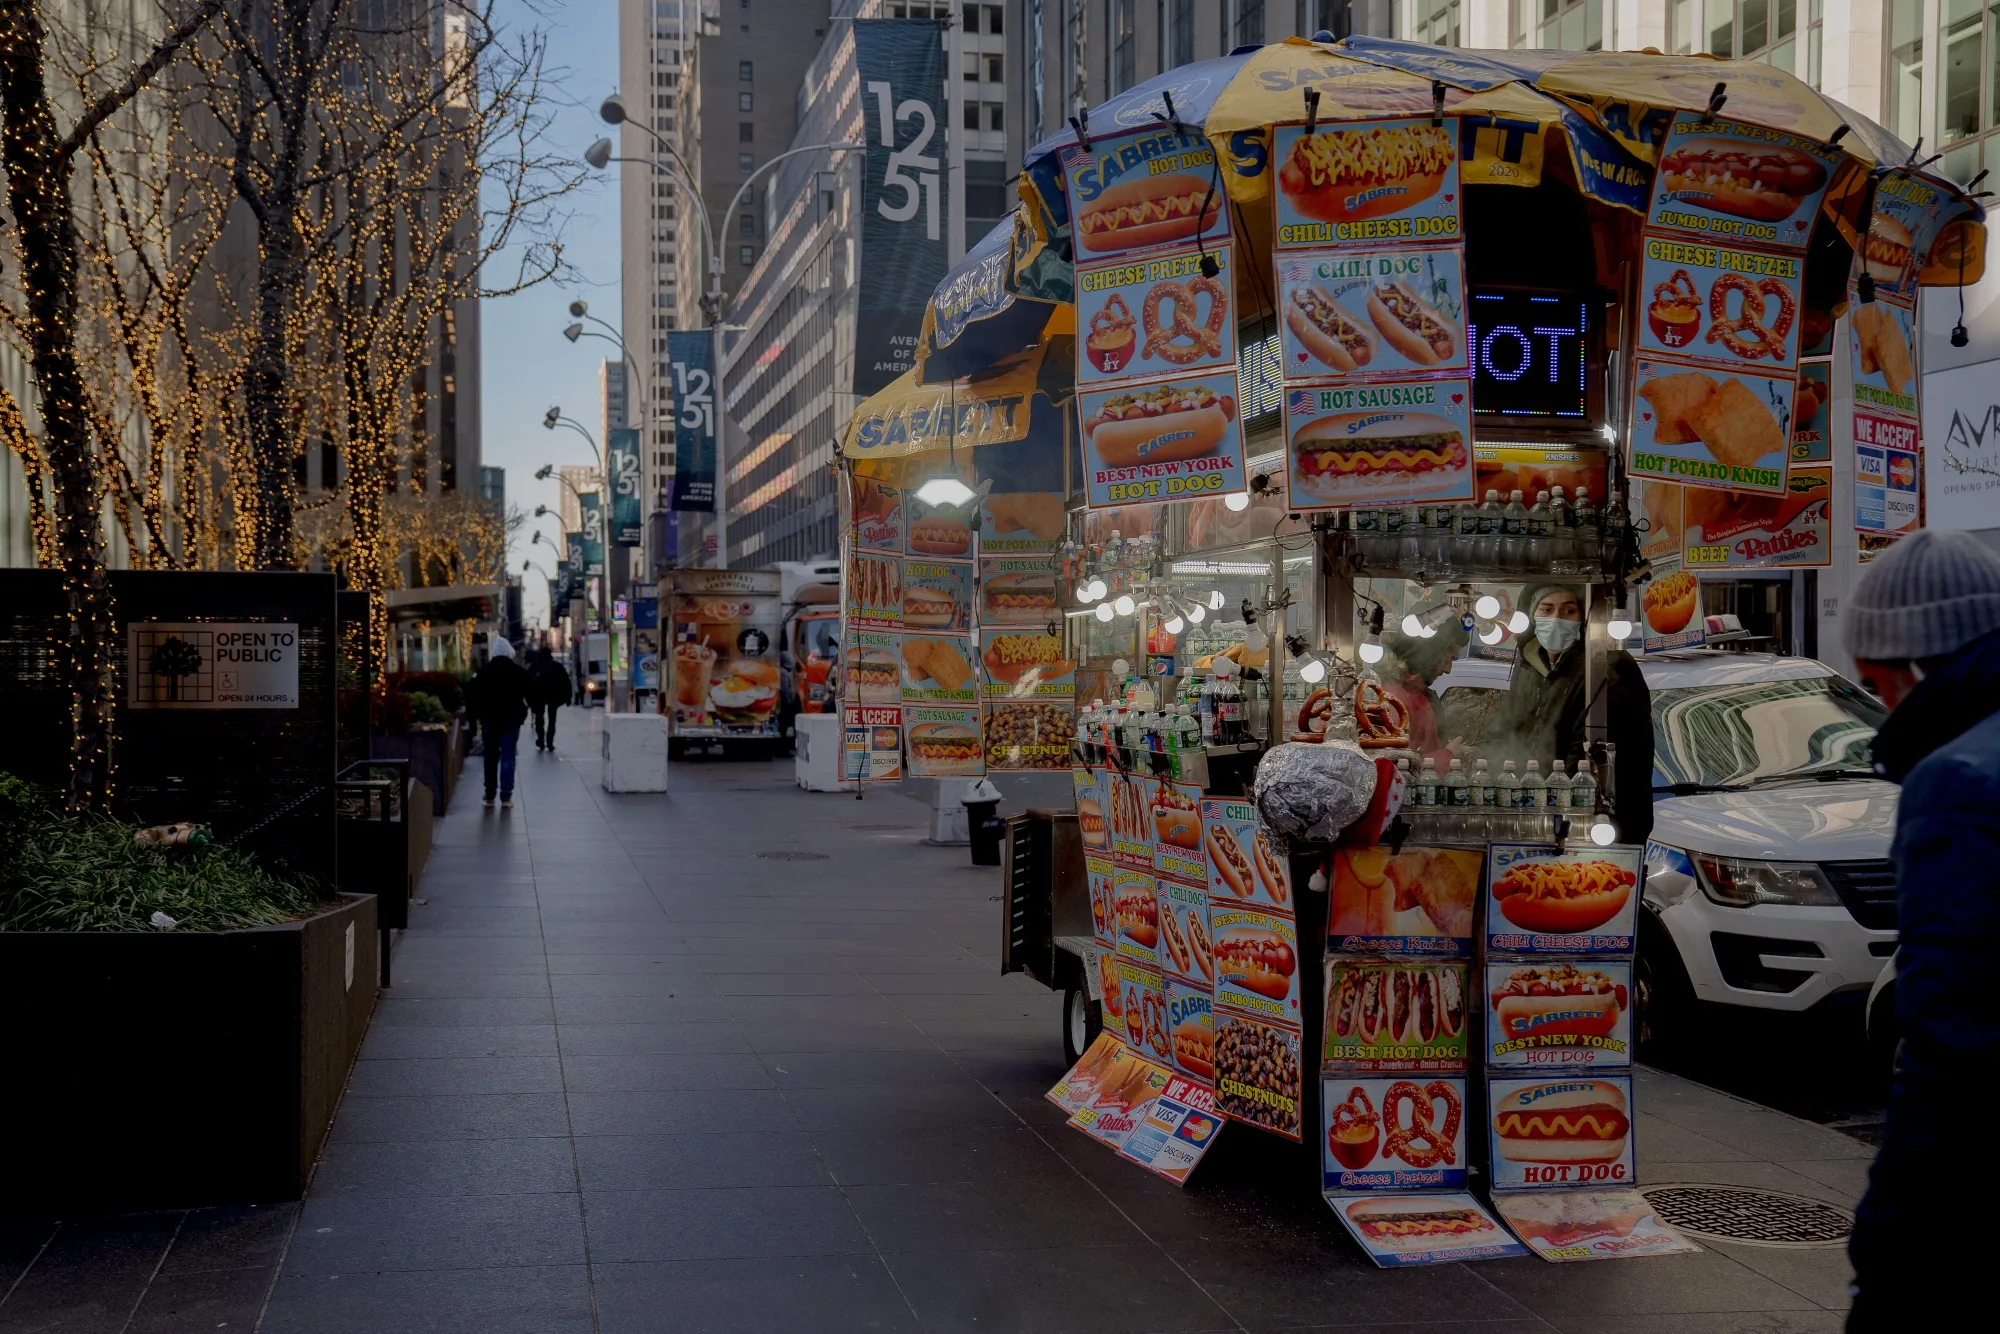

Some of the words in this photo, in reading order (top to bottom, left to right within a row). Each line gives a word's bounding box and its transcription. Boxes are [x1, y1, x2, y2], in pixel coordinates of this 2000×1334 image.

[868, 81, 939, 171] 12
[1674, 121, 1730, 136] BEST
[1733, 124, 1785, 142] NEW
[1148, 157, 1178, 176] HOT
[1181, 149, 1212, 169] DOG
[1488, 165, 1520, 179] 2020
[877, 152, 941, 240] 51
[1344, 185, 1408, 211] SABRETT
[1658, 190, 1715, 205] SABRETT
[1278, 220, 1333, 243] CHILI
[1336, 218, 1412, 240] CHEESE
[1418, 214, 1457, 235] DOG
[1657, 210, 1709, 230] JUMBO
[1711, 218, 1743, 234] HOT
[1744, 223, 1777, 240] DOG
[1316, 259, 1372, 280] CHILI
[1378, 256, 1423, 276] DOG
[1648, 241, 1717, 267] CHEESE
[1720, 251, 1798, 279] PRETZEL
[1081, 262, 1147, 292] CHEESE
[1149, 251, 1225, 281] PRETZL
[1663, 334, 1683, 346] NY
[1102, 361, 1120, 372] NY
[672, 362, 712, 402] 12
[1318, 389, 1356, 410] HOT
[1359, 385, 1436, 408] SAUSAGE
[680, 395, 713, 437] 51
[1346, 413, 1405, 434] SABRETT
[1136, 429, 1196, 458] SABRETT
[1856, 417, 1873, 442] WE
[1875, 422, 1915, 450] ACCEPT
[613, 449, 639, 477] 12
[1544, 453, 1579, 461] KNISHES
[1861, 456, 1881, 474] VISA
[1095, 464, 1138, 484] BEST
[1141, 460, 1177, 478] NEW
[1178, 455, 1235, 475] YORK
[1634, 452, 1668, 471] HOT
[1669, 458, 1729, 480] POTATO
[1731, 465, 1782, 487] KNISH
[616, 471, 640, 499] 51
[1107, 478, 1166, 501] HOT
[1168, 473, 1225, 495] DOG
[1944, 483, 1981, 495] OPENING
[1887, 500, 1915, 513] DISCOVER
[864, 523, 898, 543] Patties
[1706, 533, 1717, 541] The
[1716, 526, 1737, 539] Original
[1736, 521, 1759, 533] Jamaican
[1759, 518, 1774, 527] Style
[983, 540, 1005, 549] HOT
[1687, 545, 1731, 563] BEEF
[1734, 528, 1818, 560] Patties
[905, 563, 929, 577] HOT
[930, 566, 951, 578] DOG
[1000, 560, 1019, 571] HOT
[865, 609, 880, 618] HOT
[881, 610, 900, 619] DOG
[216, 632, 266, 646] OPEN
[270, 632, 294, 646] TO
[866, 634, 892, 646] SAUSAGE
[216, 649, 282, 662] PUBLIC
[217, 694, 243, 702] OPEN
[244, 694, 255, 702] 24
[256, 694, 288, 702] HOURS
[862, 710, 898, 724] ACCEPT
[917, 710, 932, 720] HOT
[933, 710, 966, 721] SAUSAGE
[846, 733, 865, 743] VISA
[1225, 805, 1256, 821] CHILI
[1156, 843, 1173, 855] BEST
[1173, 846, 1186, 858] NEW
[1162, 857, 1182, 869] HOT
[1182, 861, 1205, 877] DOG
[1169, 885, 1187, 902] CHILI
[1188, 890, 1203, 906] DOG
[1213, 913, 1242, 928] BEST
[1243, 912, 1268, 927] NEW
[1269, 918, 1295, 942] YORK
[1343, 935, 1403, 950] Cheese
[1491, 935, 1532, 949] CHILI
[1533, 935, 1593, 949] CHEESE
[1594, 936, 1630, 949] DOG
[1219, 990, 1249, 1006] JUMBO
[1249, 996, 1266, 1011] HOT
[1266, 1001, 1285, 1016] DOG
[1511, 1010, 1604, 1033] SABRETT
[1332, 1045, 1378, 1059] BEST
[1381, 1045, 1420, 1059] HOT
[1422, 1045, 1460, 1059] DOG
[1493, 1037, 1536, 1056] BEST
[1539, 1034, 1579, 1048] NEW
[1581, 1035, 1627, 1055] YORK
[1378, 1060, 1415, 1070] Sauerkraut
[1420, 1060, 1440, 1069] Onion
[1525, 1051, 1558, 1064] HOT
[1560, 1050, 1596, 1062] DOG
[1166, 1079, 1185, 1097] WE
[1219, 1077, 1295, 1114] CHESTNUTS
[1517, 1083, 1595, 1106] SABRETT
[1094, 1113, 1137, 1133] Patties
[1155, 1107, 1179, 1125] VISA
[1163, 1145, 1194, 1165] DISCOVER
[1340, 1172, 1391, 1186] Cheese
[1393, 1170, 1443, 1184] Pretzel
[1523, 1166, 1572, 1183] HOT
[1577, 1164, 1627, 1182] DOG
[1395, 1252, 1428, 1262] HOT
